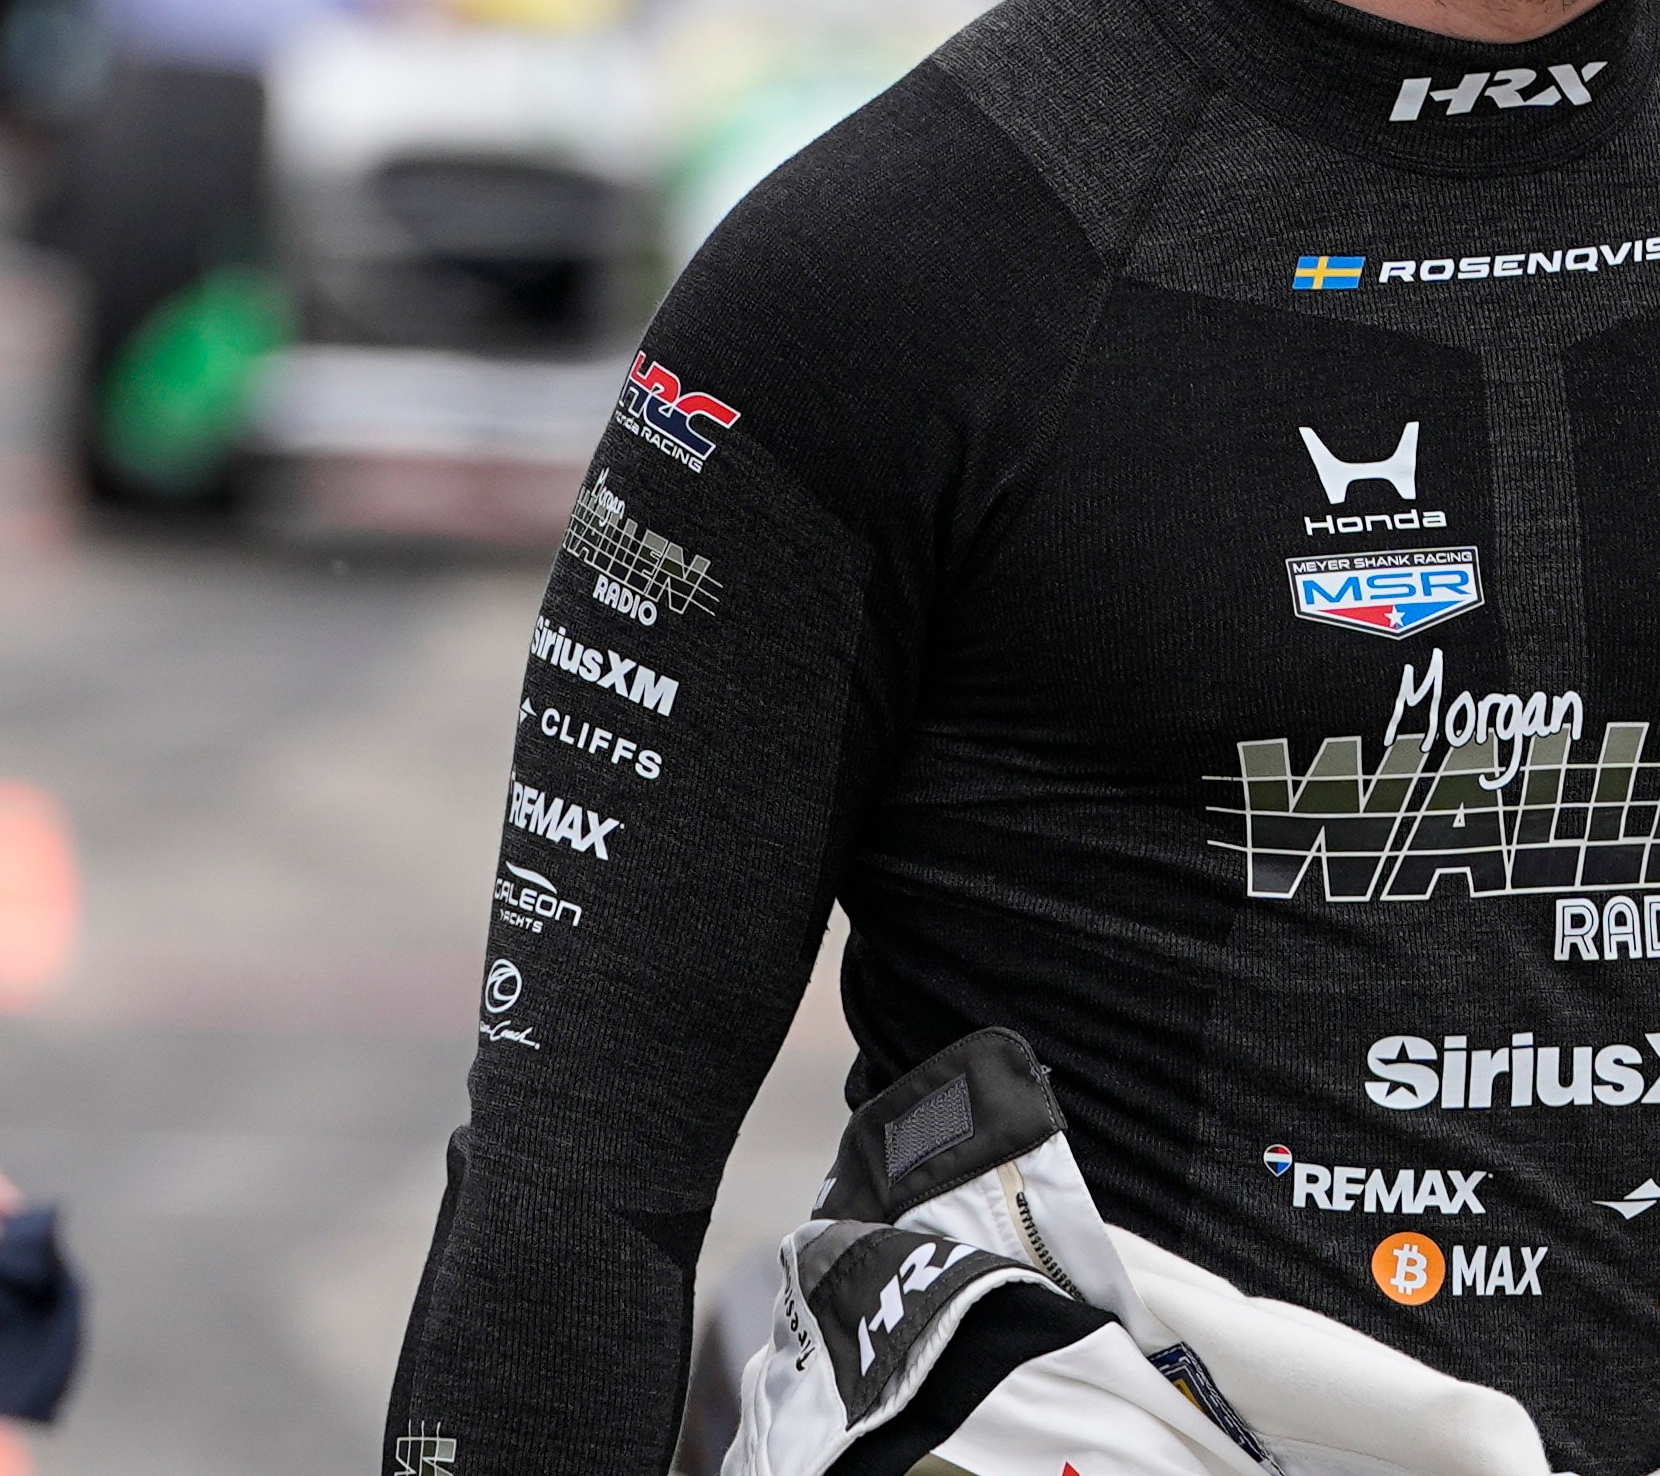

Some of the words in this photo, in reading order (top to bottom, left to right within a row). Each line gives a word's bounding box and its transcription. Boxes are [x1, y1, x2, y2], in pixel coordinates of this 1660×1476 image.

[1389, 61, 1608, 121] HRX
[640, 426, 704, 473] RACING
[1304, 509, 1447, 536] Honda
[1293, 557, 1351, 574] MEYER
[1354, 555, 1410, 568] SHANK
[1414, 551, 1472, 565] RACING
[1302, 570, 1472, 605] MSR
[593, 574, 657, 626] RADIO
[541, 708, 663, 780] CLIFFS
[1384, 648, 1584, 790] Morgan
[500, 909, 543, 934] YACHTS
[1292, 1163, 1487, 1215] REMAX
[1452, 1245, 1548, 1297] MAX
